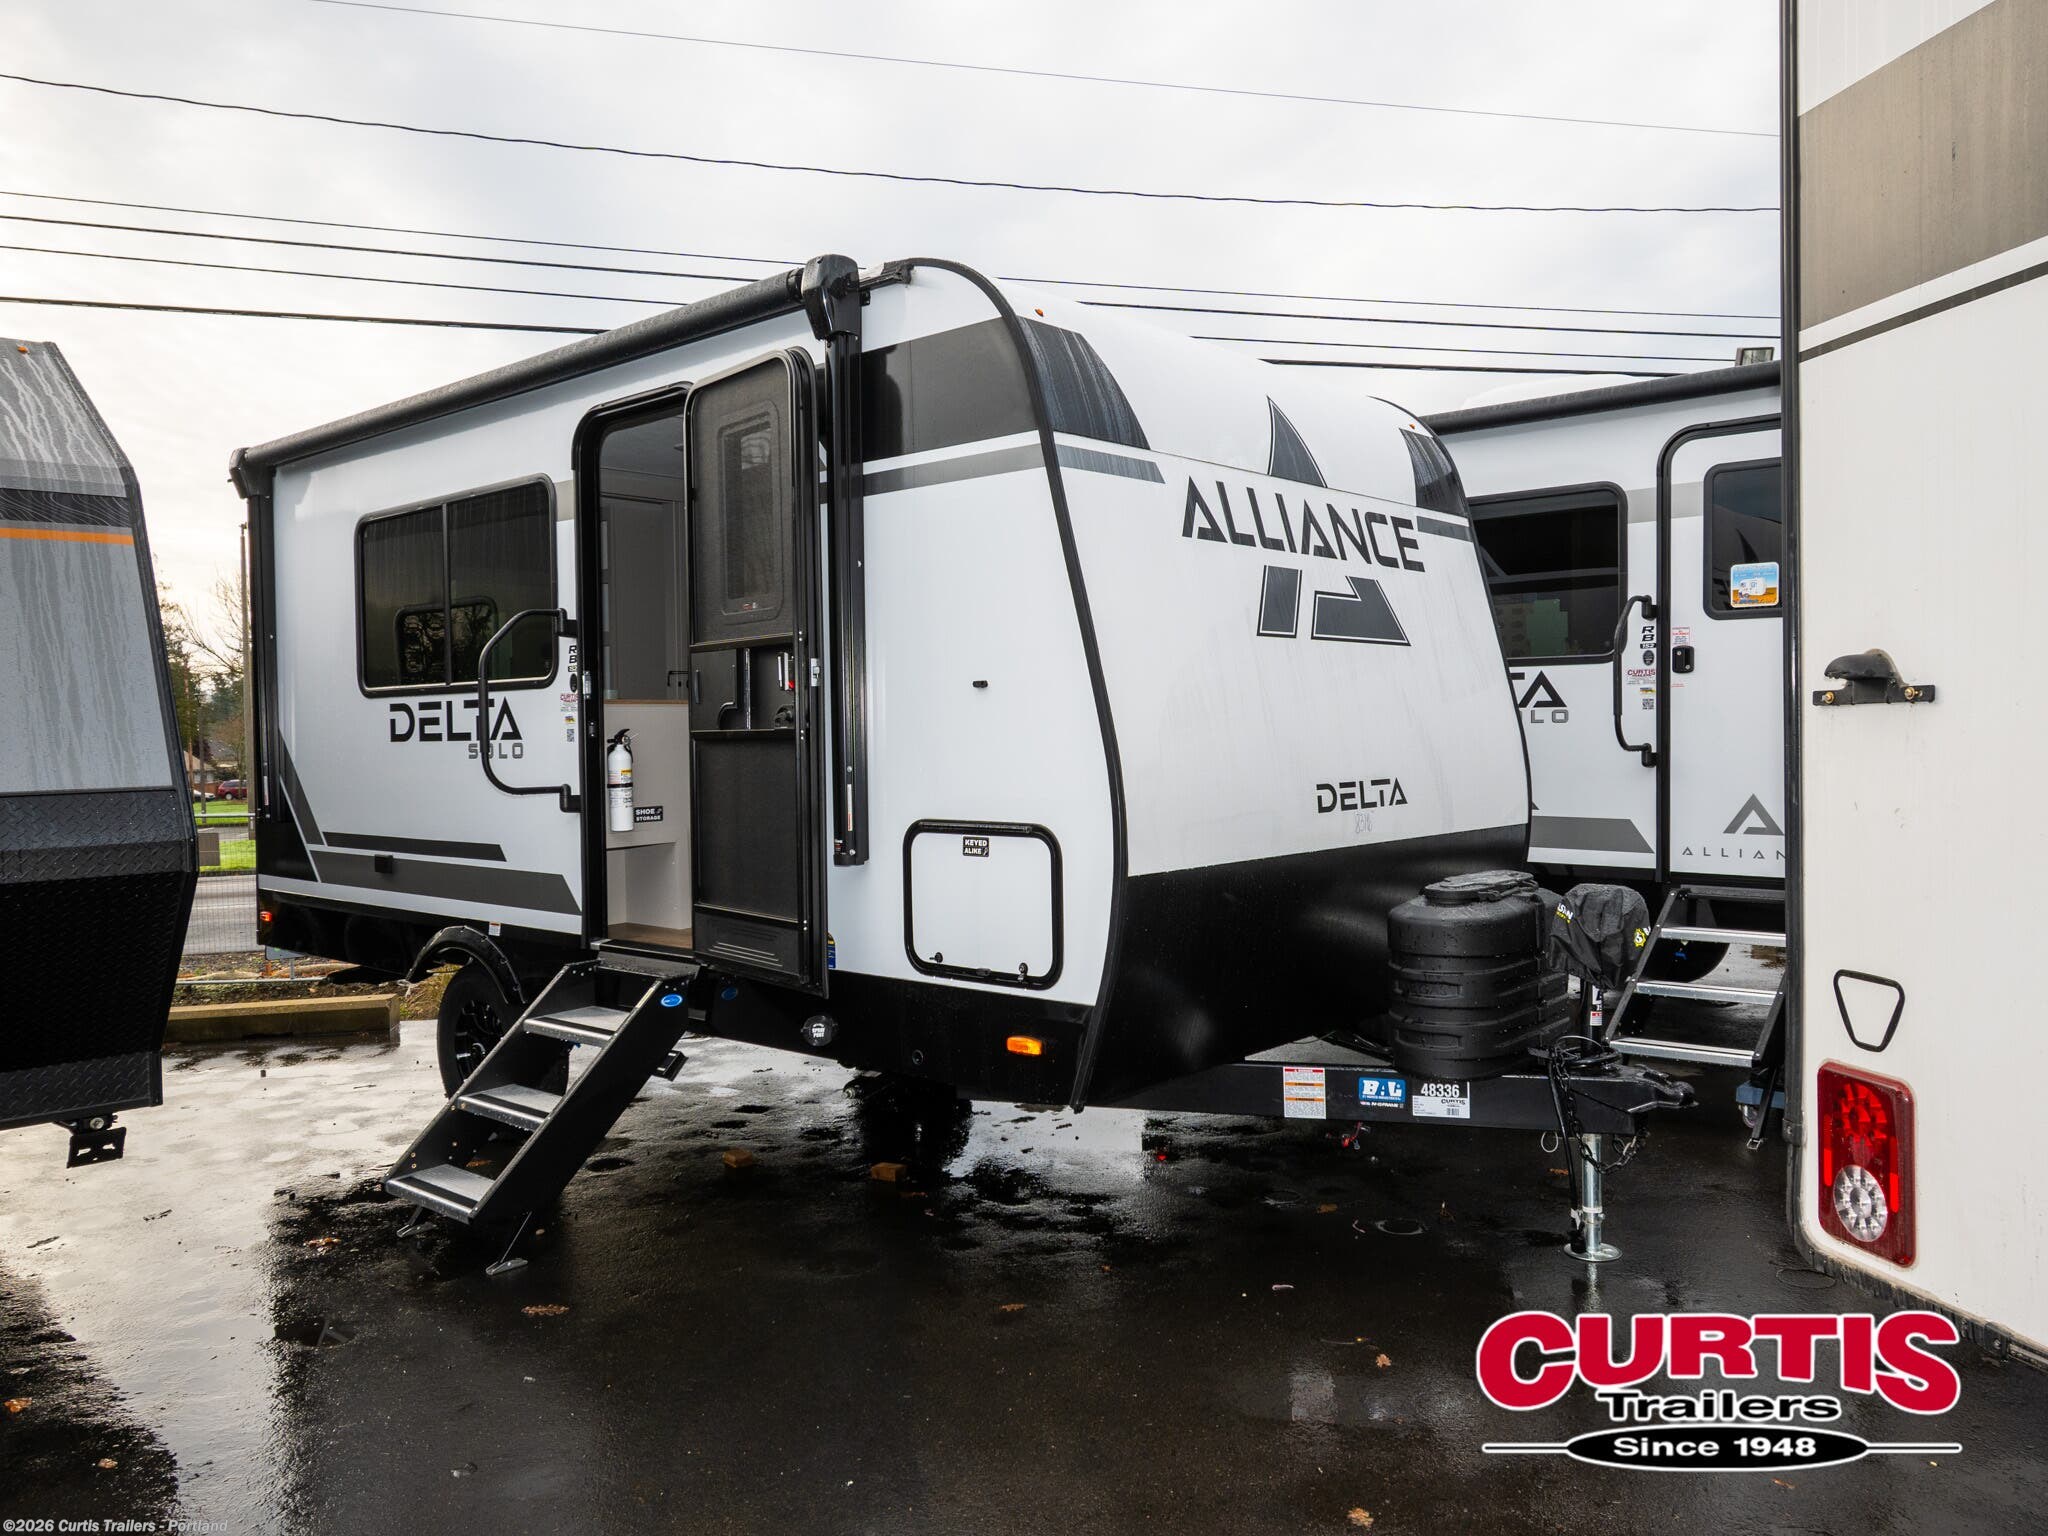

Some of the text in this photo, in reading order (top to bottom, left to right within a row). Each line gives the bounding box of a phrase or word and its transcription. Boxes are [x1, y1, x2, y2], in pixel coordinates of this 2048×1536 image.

[1182, 475, 1426, 573] ALLIANCE
[389, 696, 523, 742] DELTA
[1316, 777, 1408, 814] DELTA
[964, 839, 988, 847] KEYED
[964, 847, 982, 855] ALIKE
[1420, 1083, 1460, 1098] 48336
